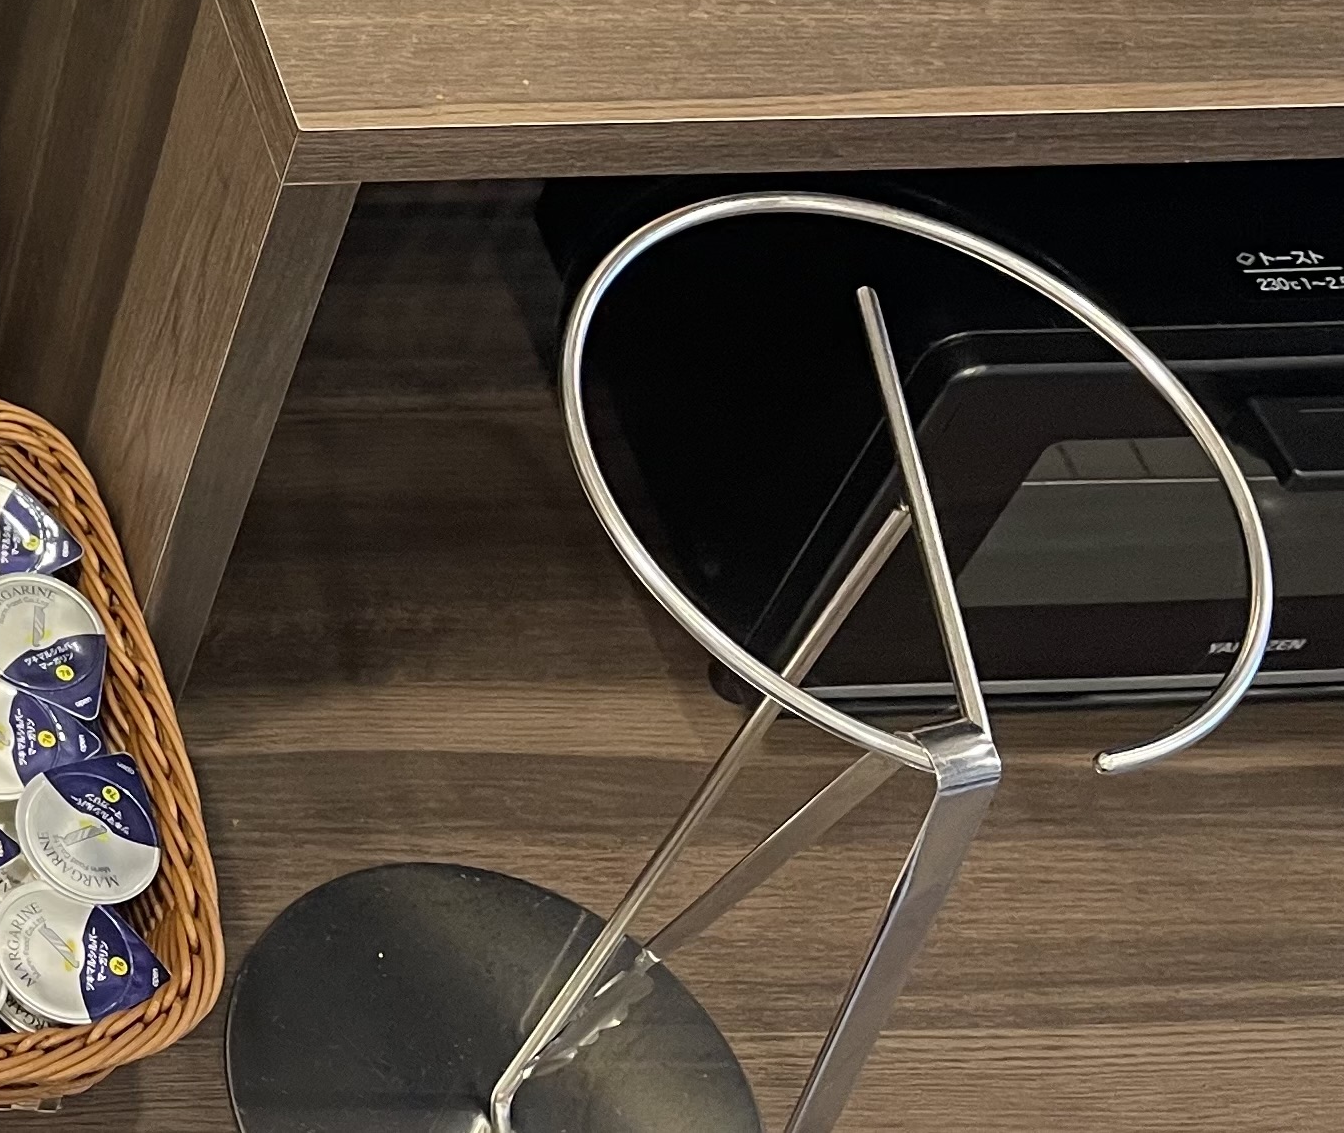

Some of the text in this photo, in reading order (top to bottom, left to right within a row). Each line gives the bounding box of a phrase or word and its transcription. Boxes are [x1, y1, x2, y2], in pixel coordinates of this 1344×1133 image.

[1258, 250, 1325, 266] トースト
[38, 832, 120, 887] MARGARINE
[8, 902, 43, 987] MARGARINE
